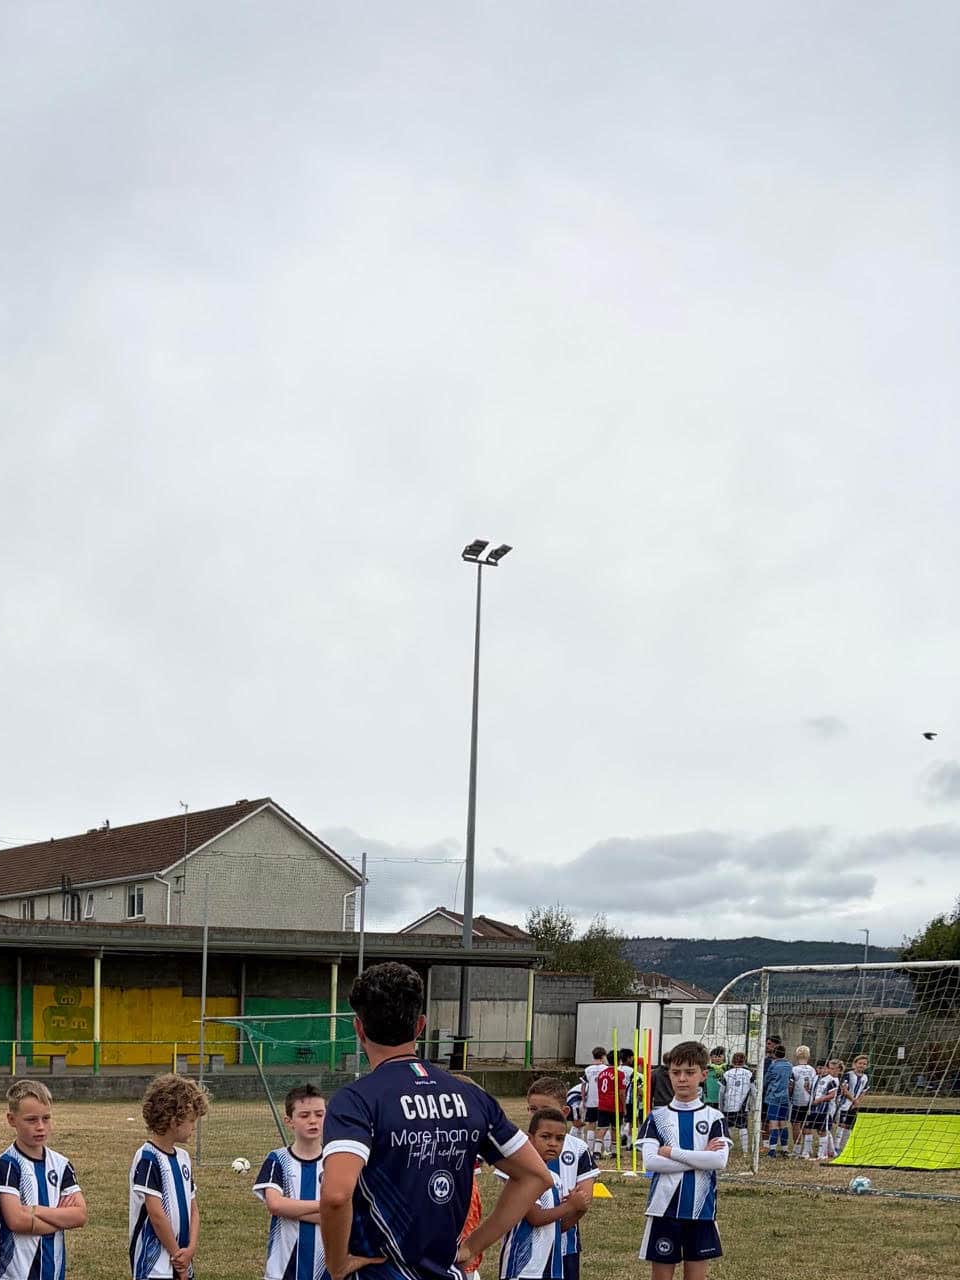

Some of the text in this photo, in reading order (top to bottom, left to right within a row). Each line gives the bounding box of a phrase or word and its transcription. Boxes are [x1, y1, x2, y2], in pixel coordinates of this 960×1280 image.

[601, 1078, 608, 1093] 8
[400, 1093, 468, 1120] COACH
[391, 1127, 480, 1147] More than a
[435, 1181, 448, 1192] MA
